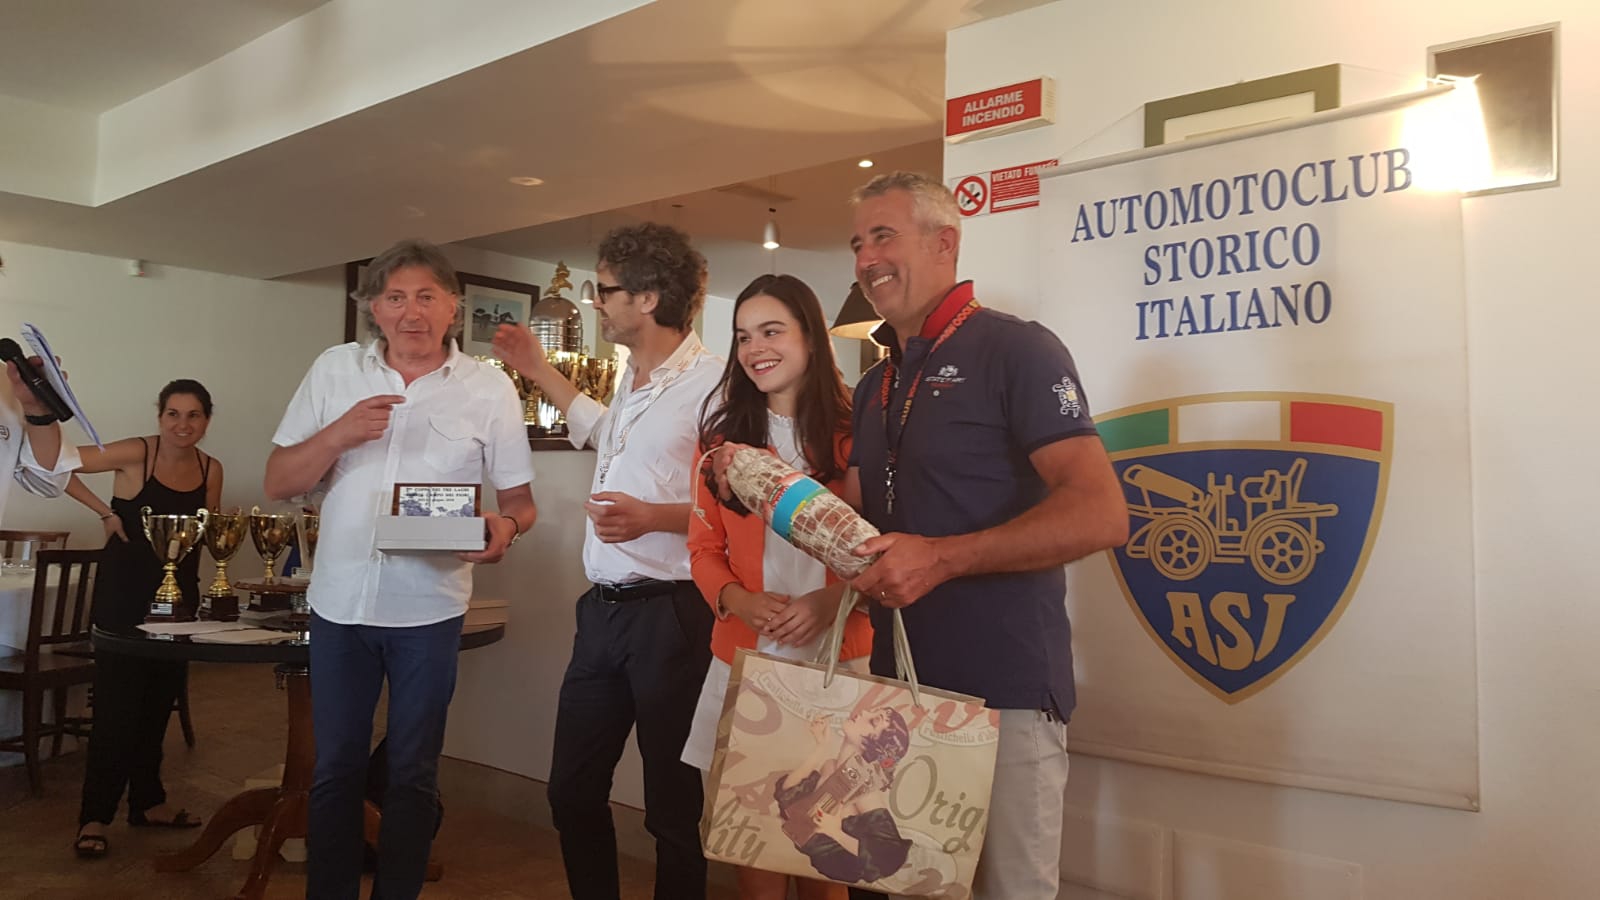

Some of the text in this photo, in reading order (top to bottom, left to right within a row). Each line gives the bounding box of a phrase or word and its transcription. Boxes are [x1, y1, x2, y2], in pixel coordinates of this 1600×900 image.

[962, 104, 1025, 127] INCENDIO
[964, 90, 1024, 114] ALLARME
[992, 168, 1022, 182] VIETATO
[1071, 148, 1412, 243] AUTOMOTOCLUB
[1144, 222, 1320, 286] STORICO
[1135, 280, 1332, 341] ITALIANO
